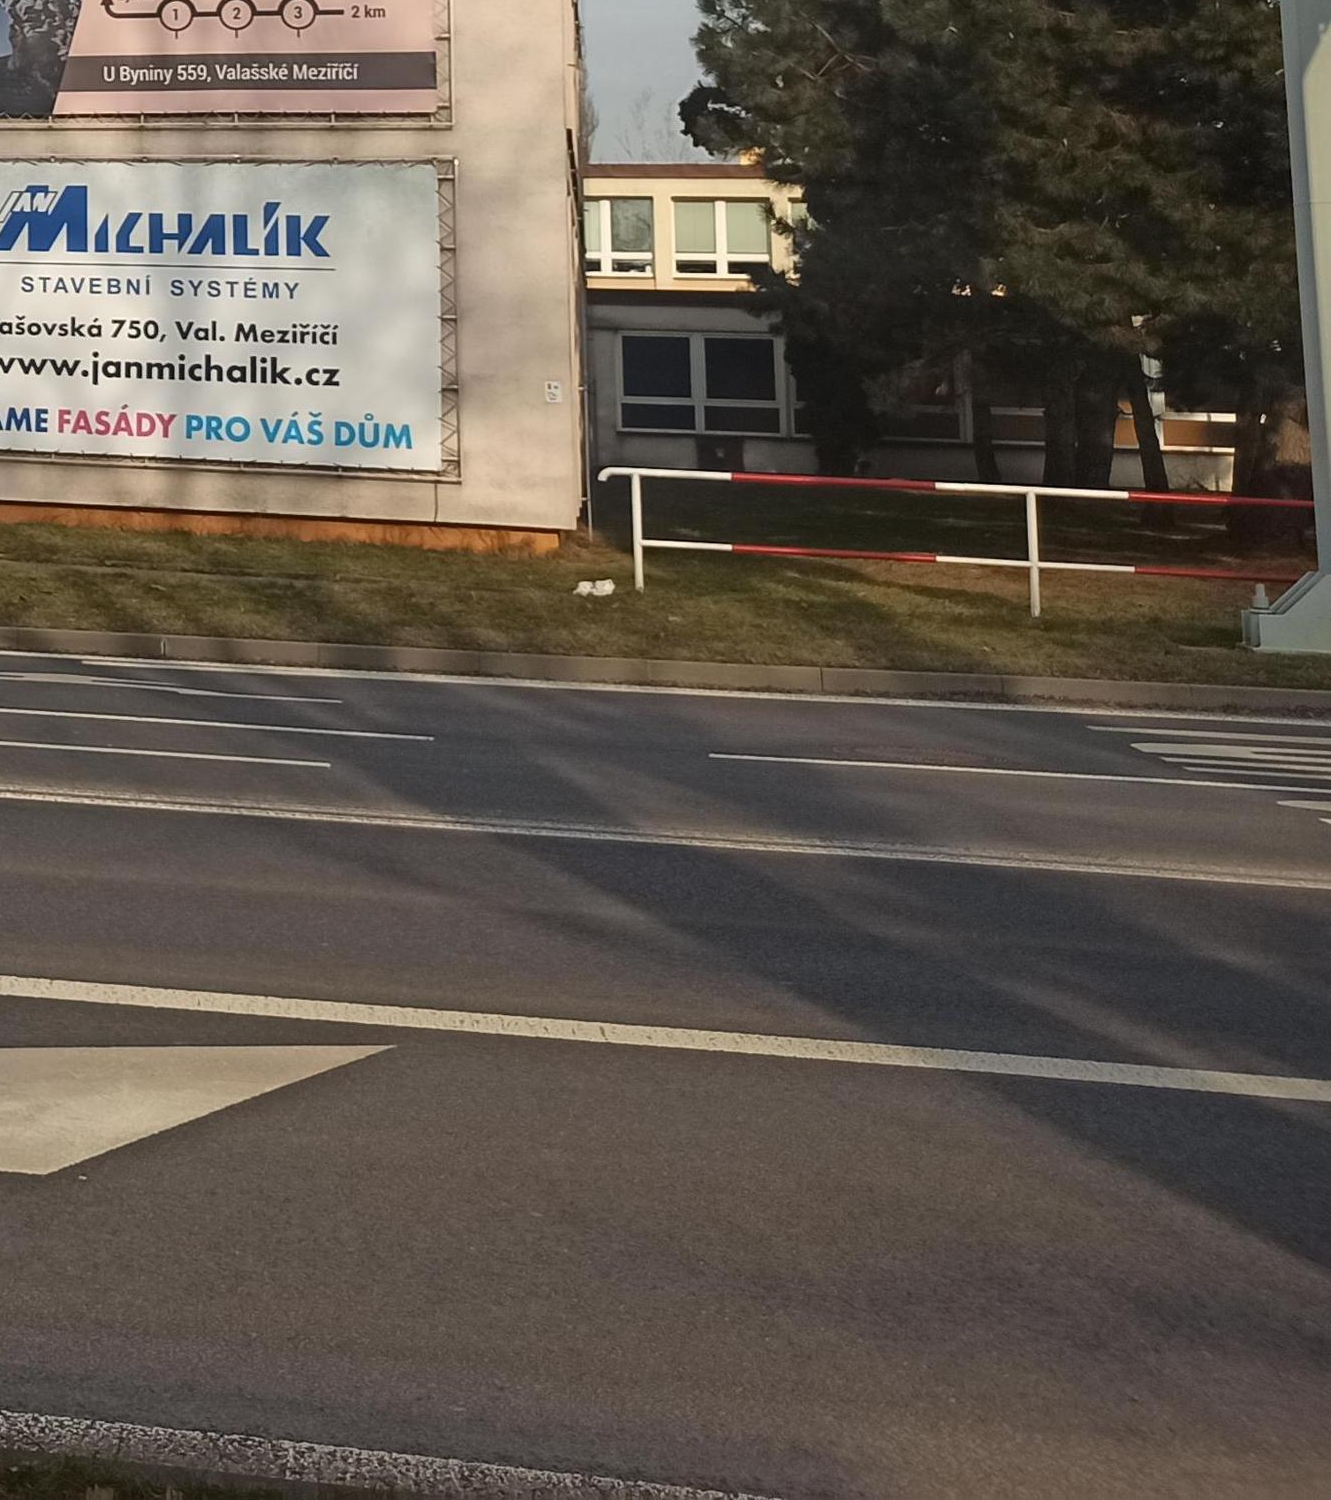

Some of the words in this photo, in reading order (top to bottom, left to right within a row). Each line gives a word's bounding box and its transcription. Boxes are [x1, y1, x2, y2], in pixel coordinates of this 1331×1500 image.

[232, 7, 242, 20] 2
[293, 6, 303, 19] 3
[350, 5, 361, 18] 2
[364, 4, 386, 18] km
[103, 66, 115, 82] U
[119, 65, 173, 85] Byniny
[177, 64, 212, 82] 559,
[215, 63, 289, 81] Valašské
[293, 62, 358, 81] Meziříčí
[21, 275, 151, 296] STAVEBNÍ
[170, 277, 300, 300] SYSTÉMY
[111, 318, 167, 343] 750,
[175, 320, 226, 342] Val.
[234, 323, 339, 346] Meziříčí
[57, 404, 178, 439] FASÁDY
[185, 414, 251, 443] PRO
[259, 411, 324, 446] VÁŠ
[333, 413, 414, 450] DŮM
